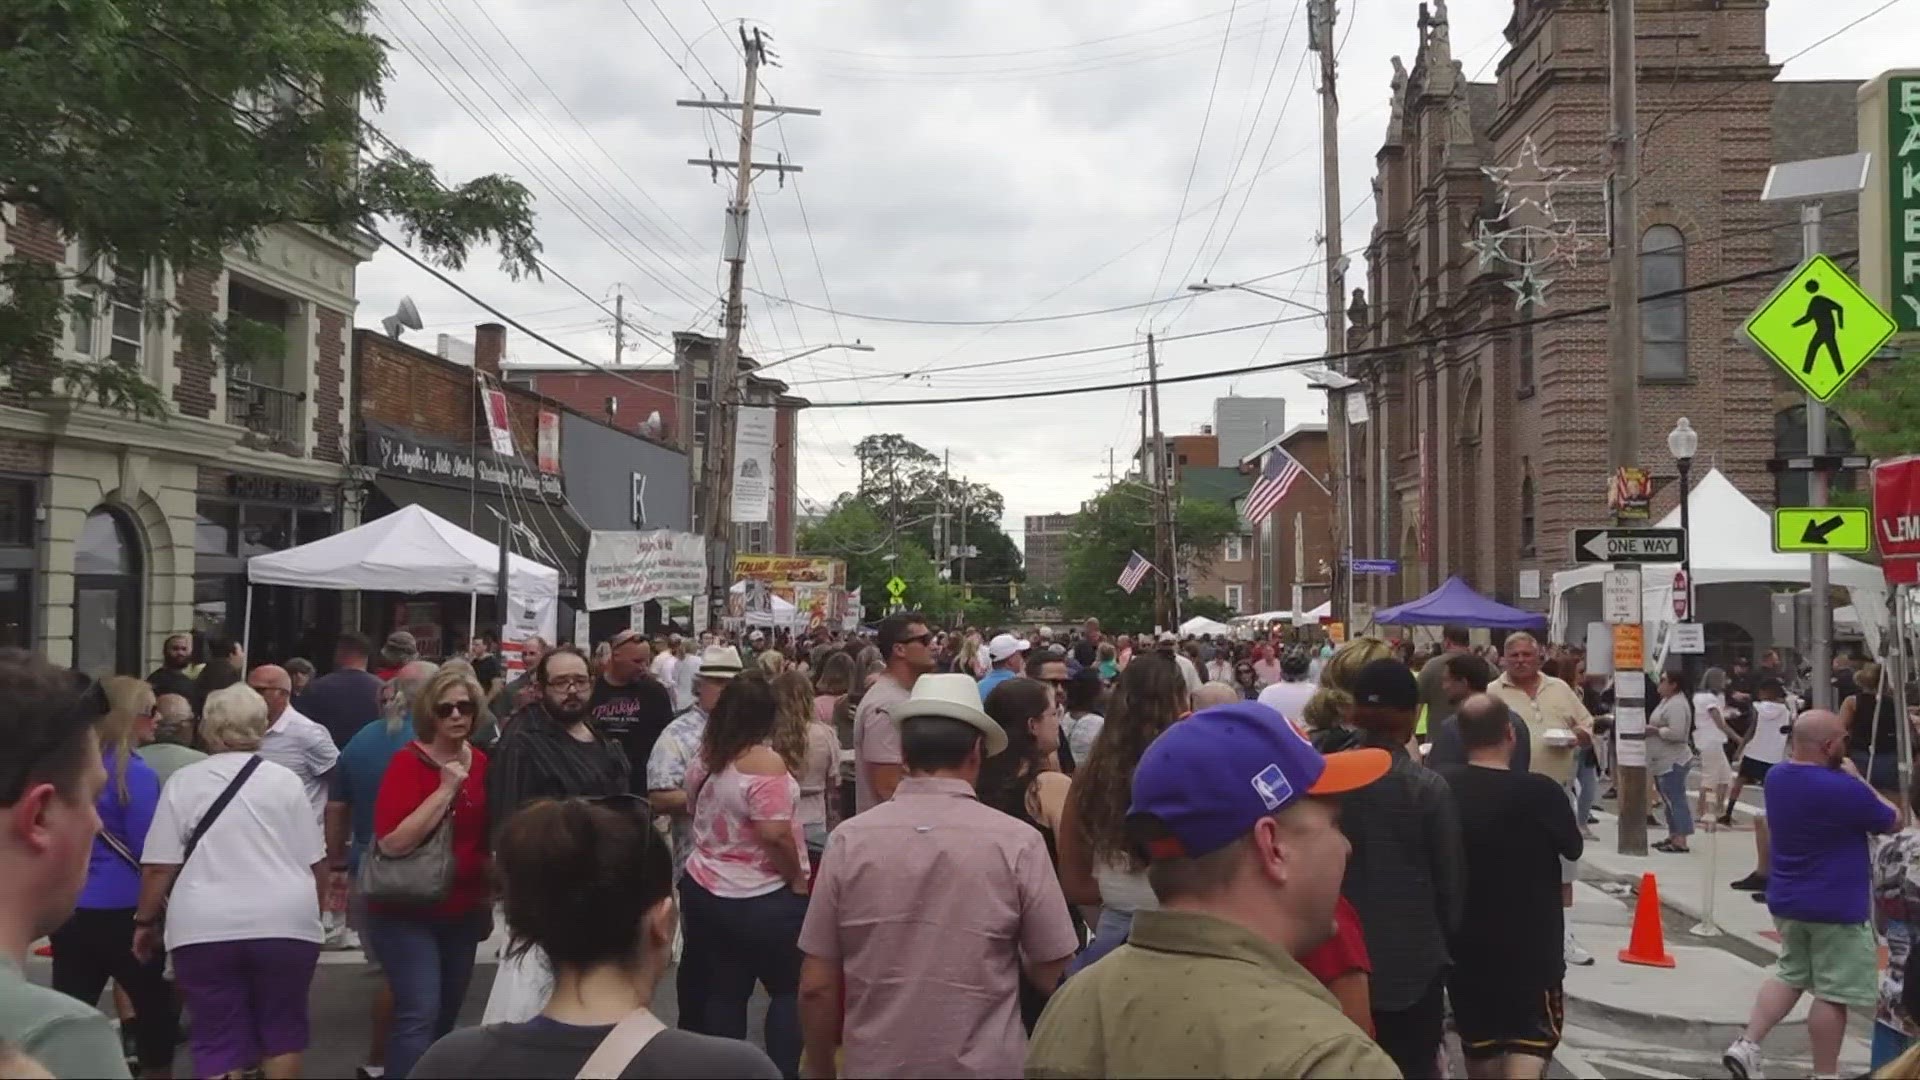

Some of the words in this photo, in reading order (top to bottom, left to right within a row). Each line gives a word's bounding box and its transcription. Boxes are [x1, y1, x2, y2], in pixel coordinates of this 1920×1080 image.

[1607, 540, 1637, 553] ONE
[1643, 539, 1673, 552] WAY
[1615, 576, 1629, 586] NO
